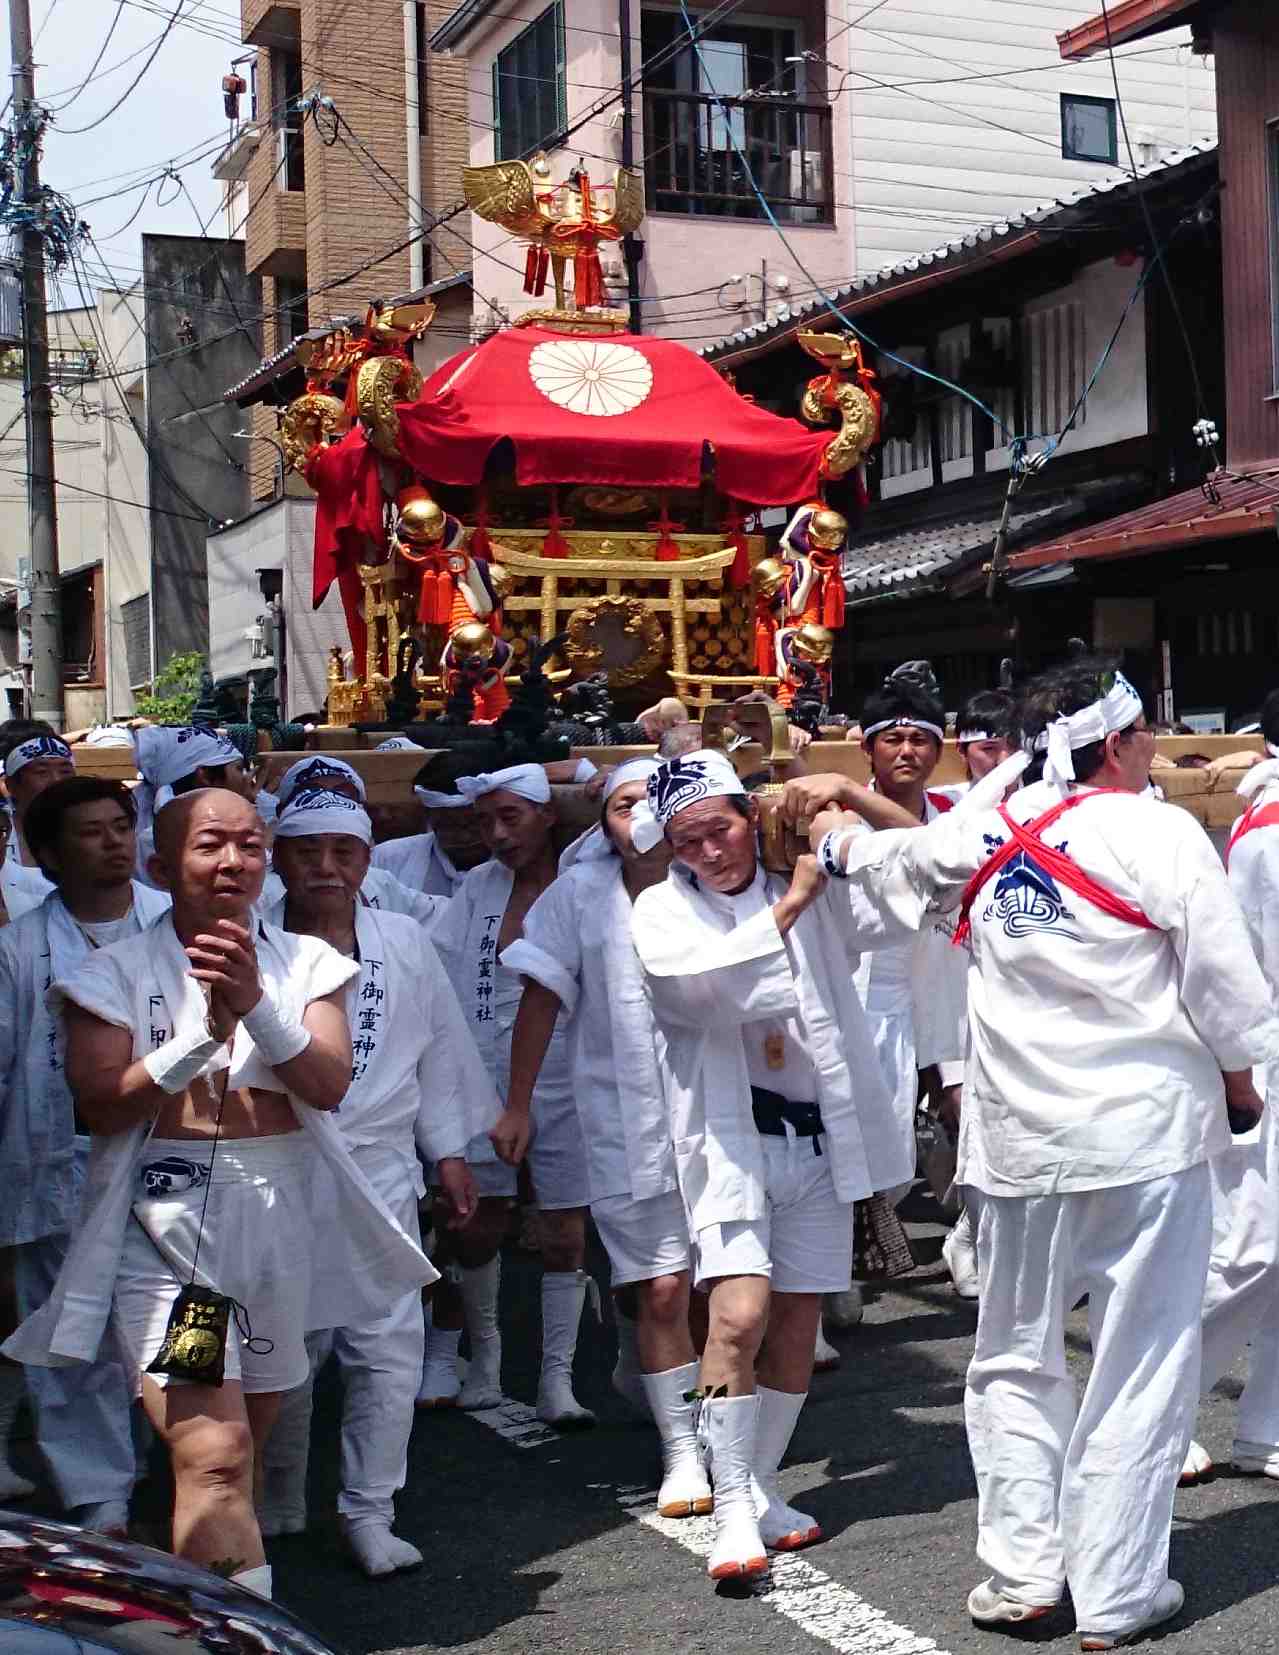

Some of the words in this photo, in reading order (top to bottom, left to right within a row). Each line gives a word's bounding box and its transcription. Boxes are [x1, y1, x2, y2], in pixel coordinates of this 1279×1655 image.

[475, 914, 501, 1022] 下御霊神社
